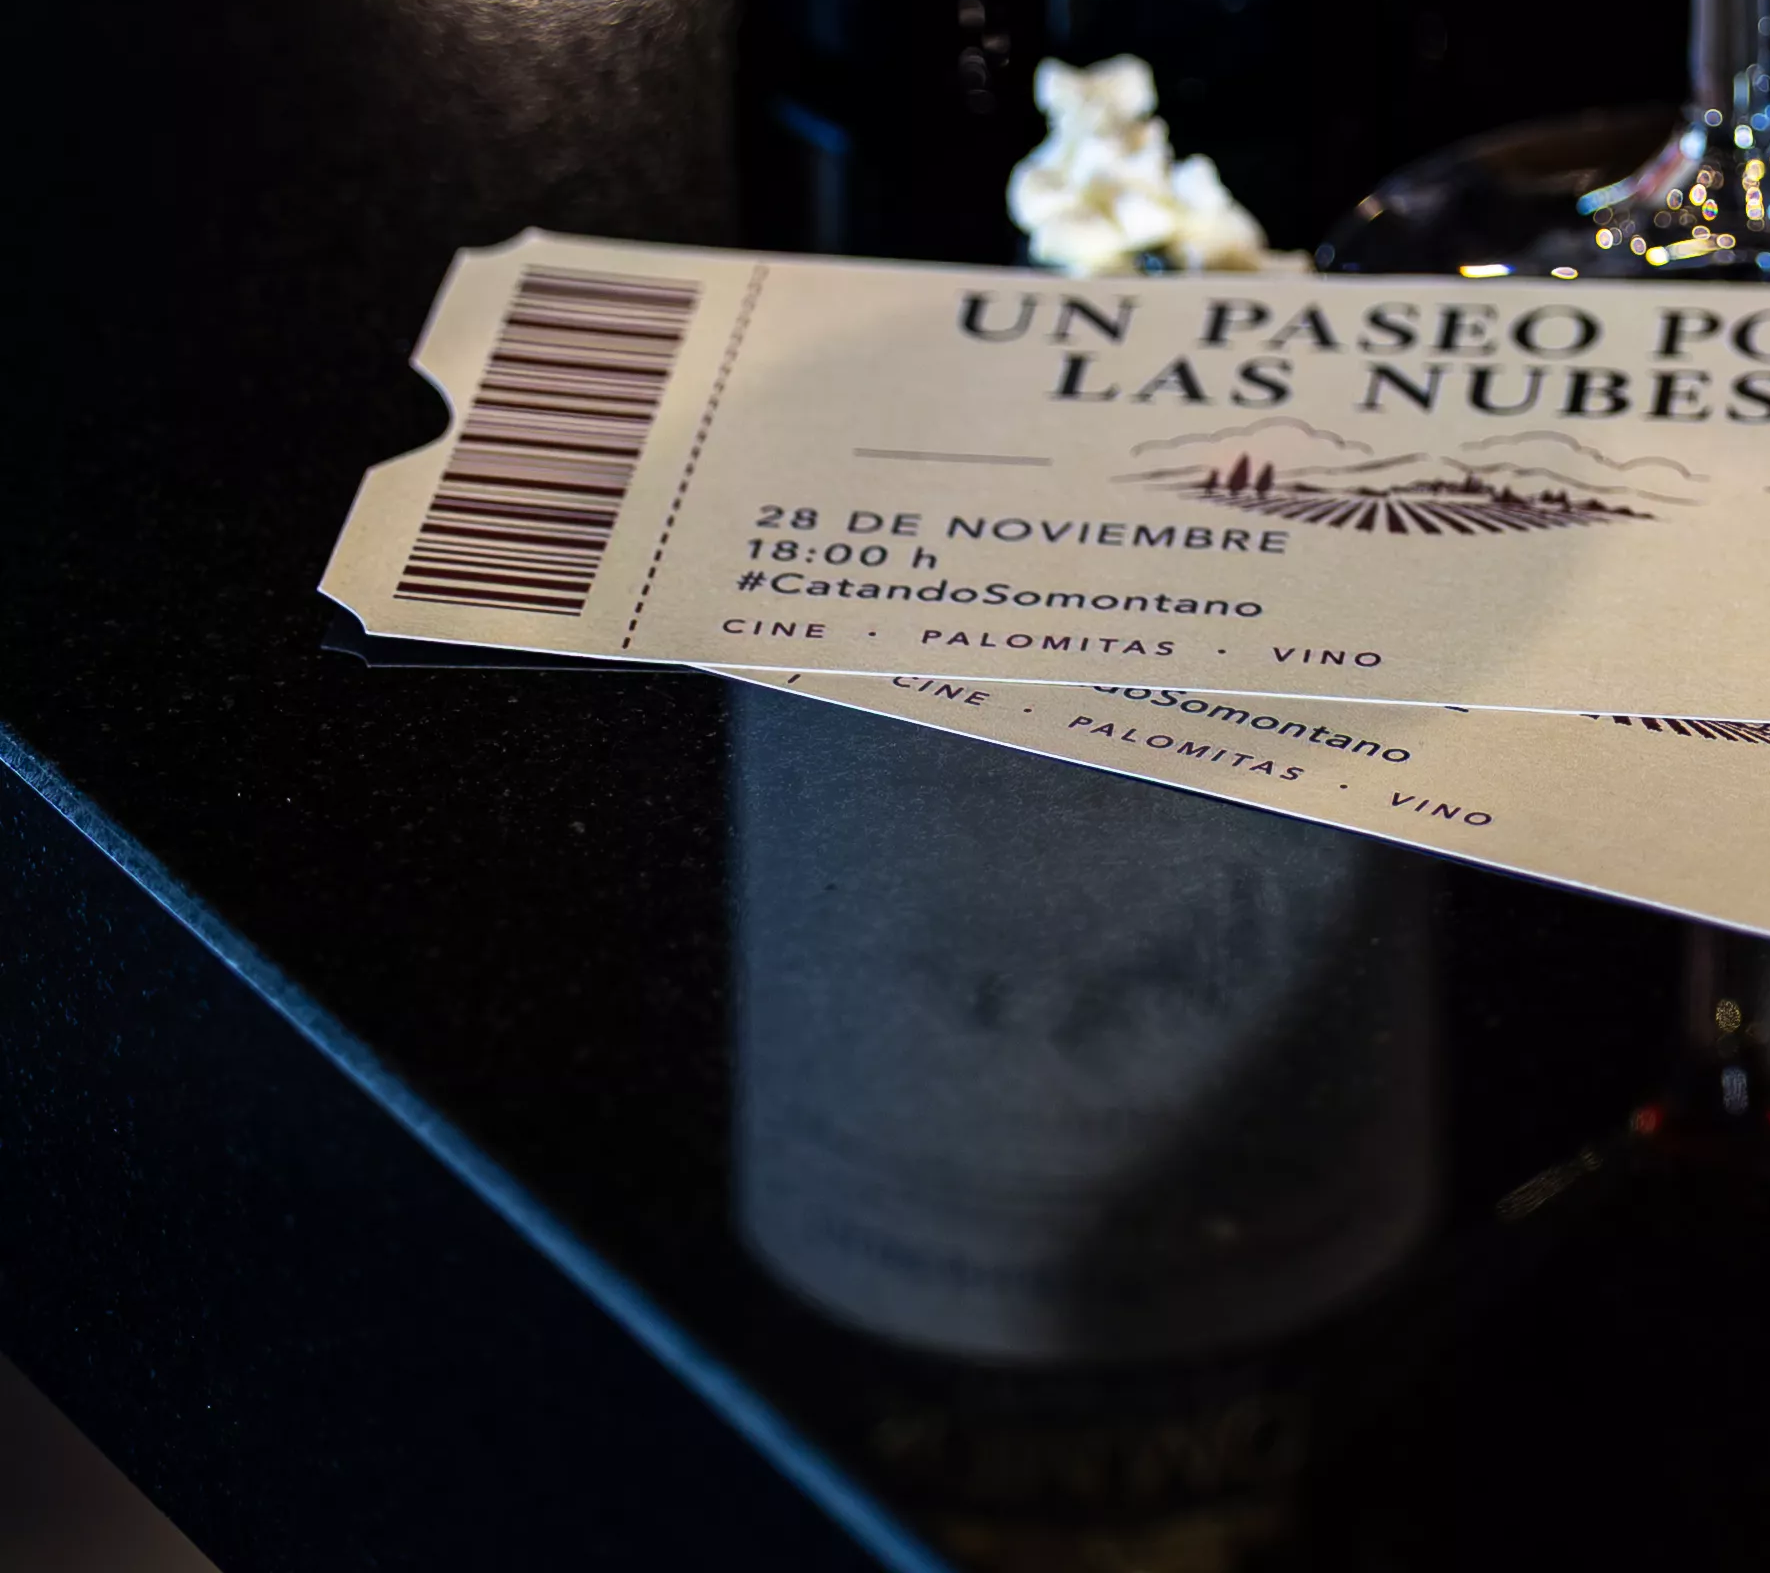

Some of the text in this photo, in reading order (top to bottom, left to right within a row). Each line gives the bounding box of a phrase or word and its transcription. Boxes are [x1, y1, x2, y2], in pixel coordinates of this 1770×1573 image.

[956, 291, 1138, 345] UN
[1198, 298, 1602, 359] PASEO
[1047, 352, 1294, 409] LAS
[745, 538, 938, 571] 18:00 h
[755, 505, 1290, 557] 28 DE NOVIEMBRE
[735, 570, 1264, 620] #CatandoSomontano
[722, 619, 1383, 669] CINE PALOMITAS VINO
[892, 676, 1493, 829] CINE PALOMITAS VINO
